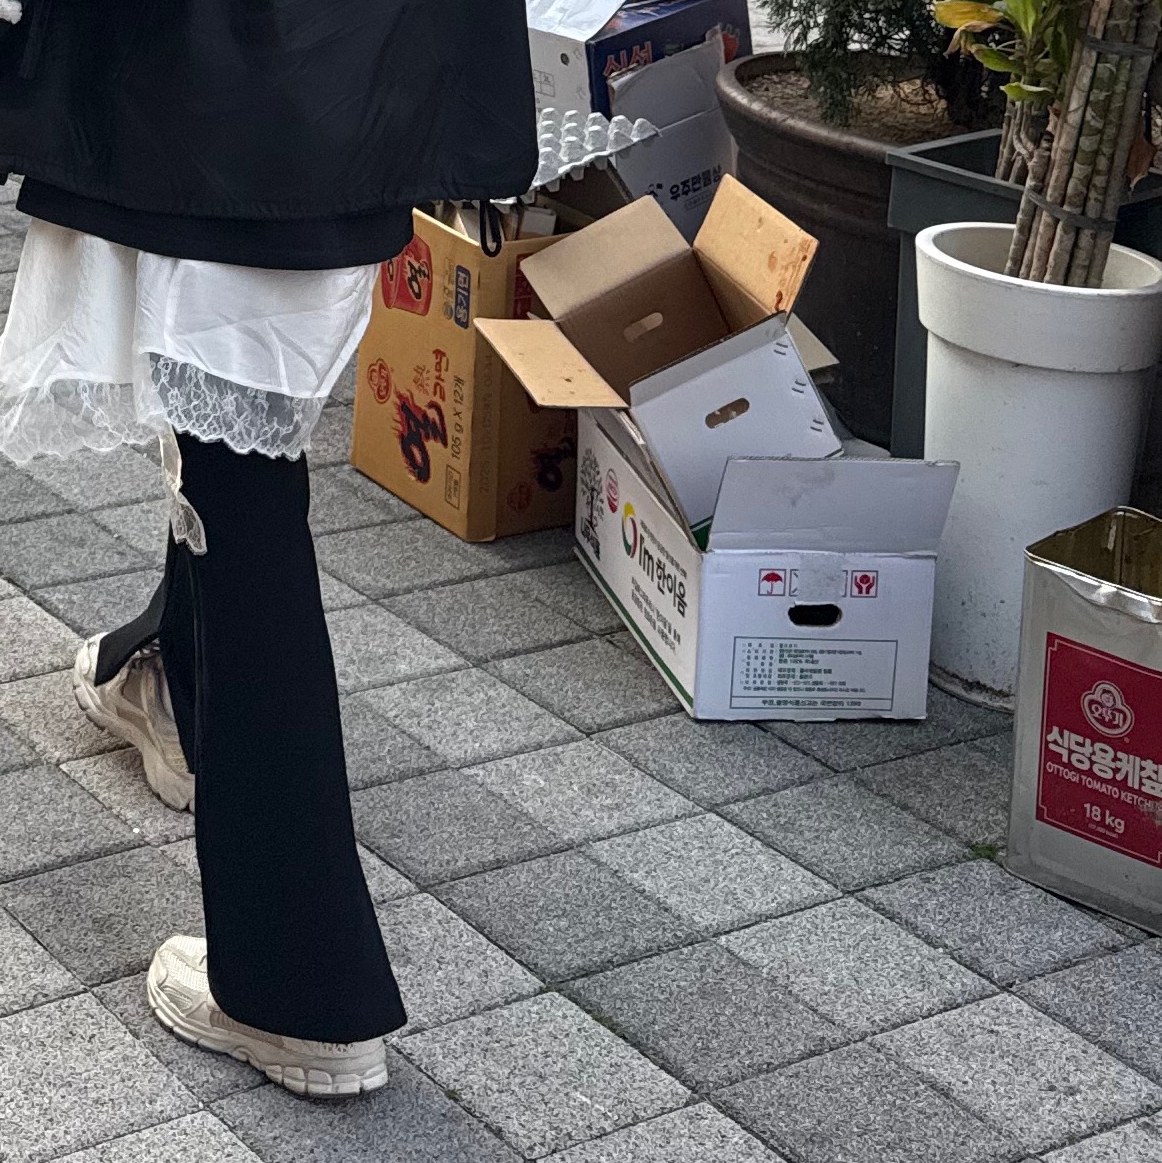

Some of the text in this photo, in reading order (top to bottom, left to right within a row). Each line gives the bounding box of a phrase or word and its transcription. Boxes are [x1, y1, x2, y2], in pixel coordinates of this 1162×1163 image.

[453, 375, 465, 408] 12개
[450, 438, 462, 460] 105
[1090, 704, 1124, 728] 오뚜기
[1046, 761, 1080, 784] OTTOGI
[1081, 774, 1120, 799] TOMATO
[1084, 803, 1102, 822] 18
[1105, 810, 1126, 834] kg
